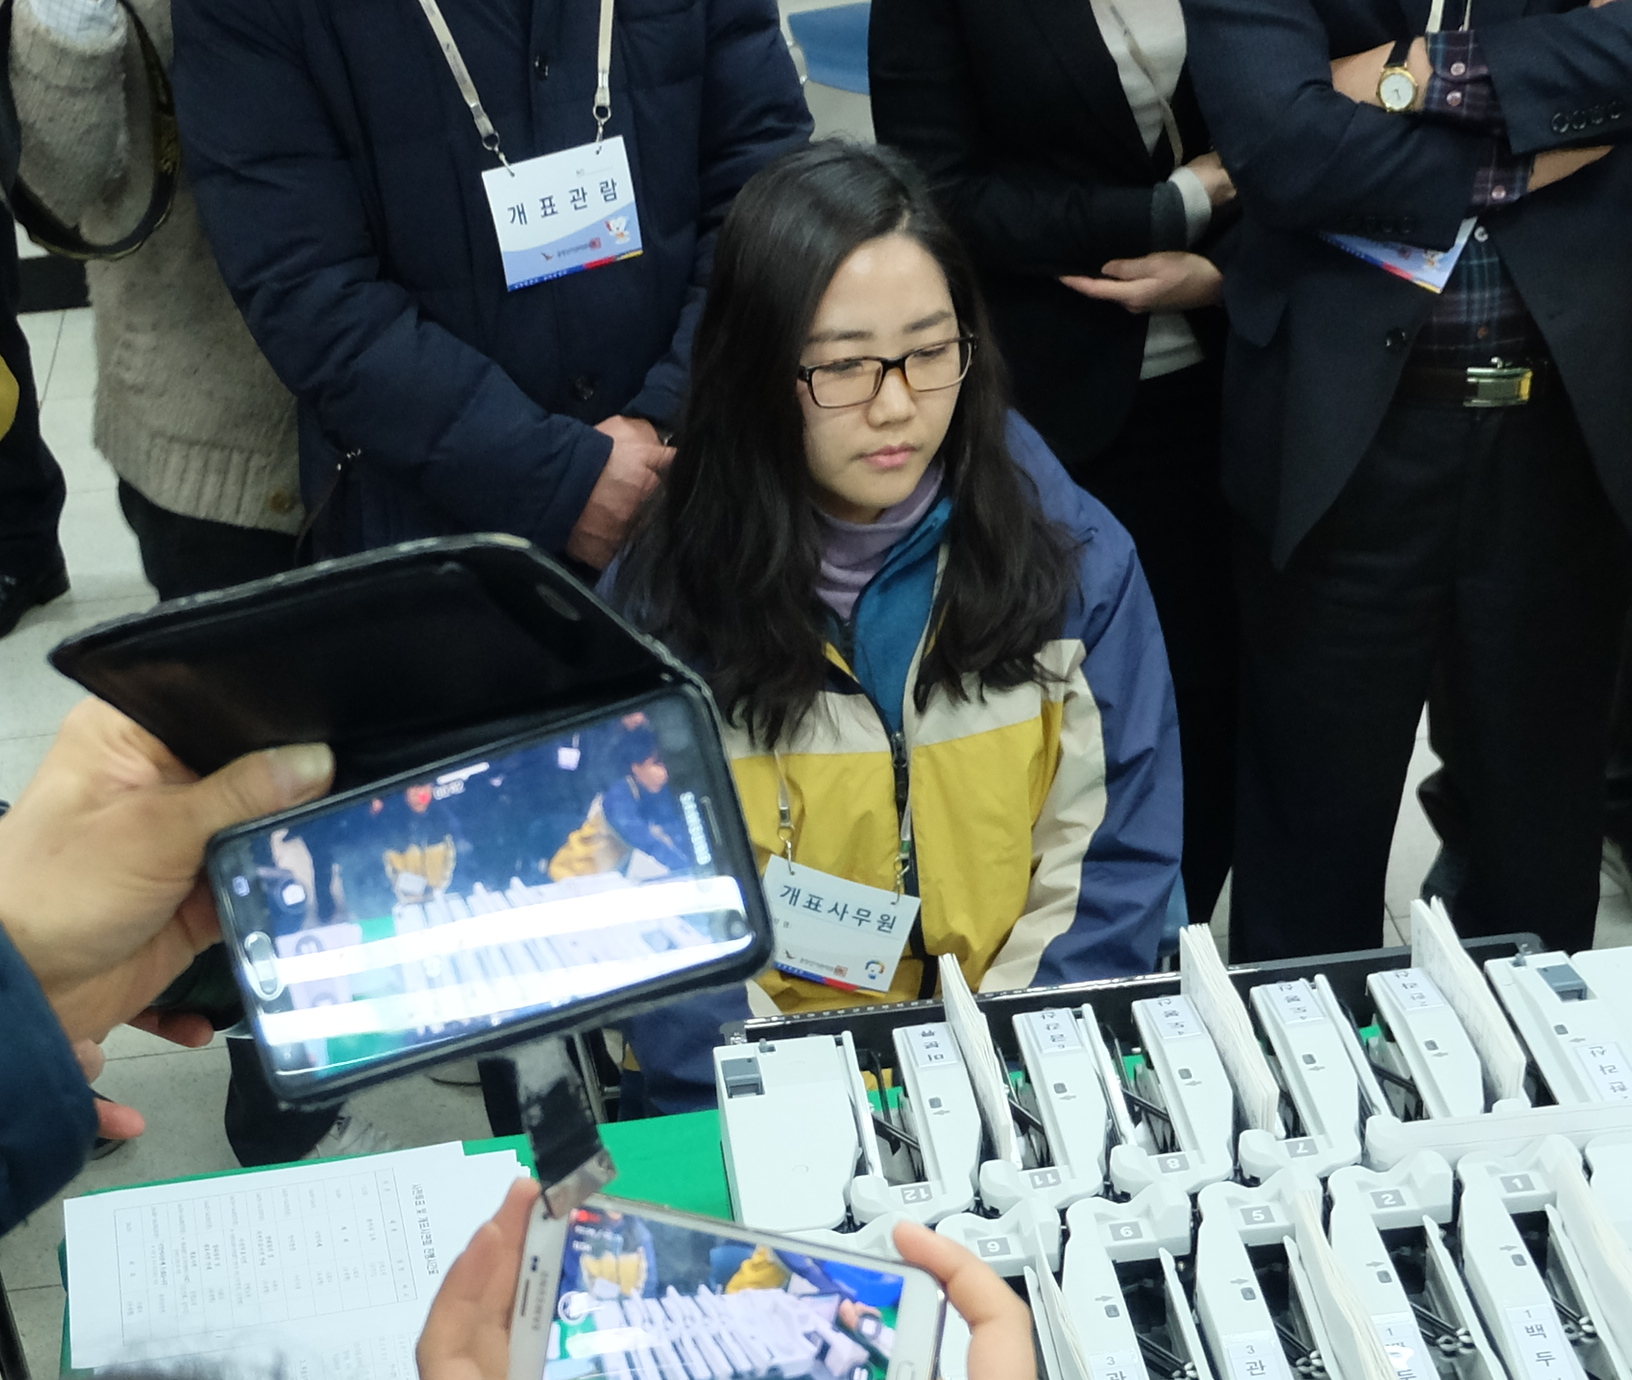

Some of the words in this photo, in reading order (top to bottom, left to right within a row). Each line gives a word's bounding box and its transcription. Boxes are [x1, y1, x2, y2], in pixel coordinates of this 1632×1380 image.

[506, 178, 618, 226] 개표관람
[779, 884, 897, 934] 개표사무원
[1588, 1044, 1629, 1093] 한라산
[902, 1188, 930, 1201] 12
[1031, 1171, 1059, 1184] 11
